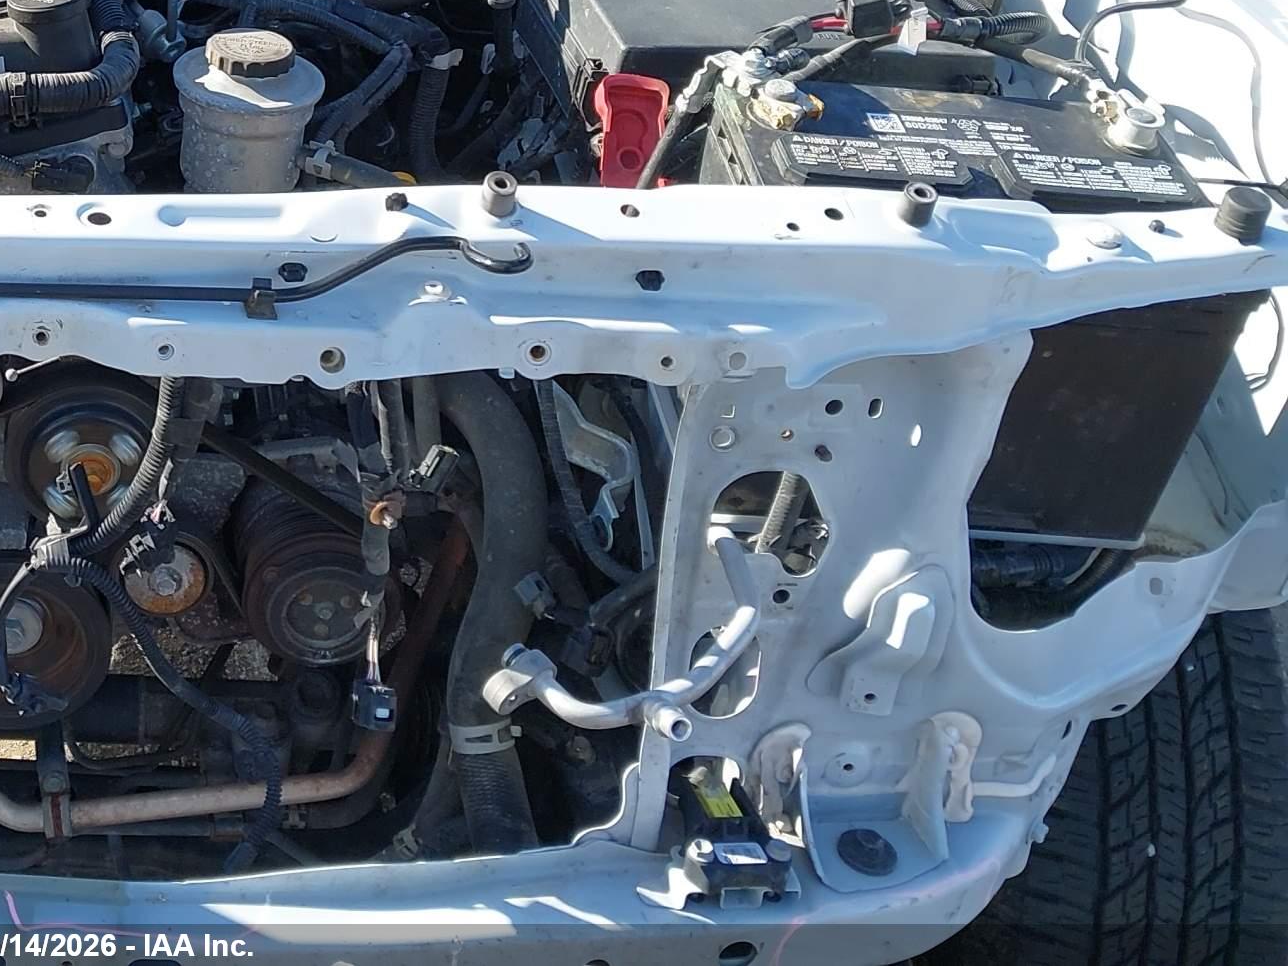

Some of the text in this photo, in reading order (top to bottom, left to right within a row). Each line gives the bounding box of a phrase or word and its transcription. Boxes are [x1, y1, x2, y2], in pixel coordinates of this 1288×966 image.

[803, 135, 839, 146] DANGER
[845, 139, 880, 149] POISON
[1023, 153, 1061, 163] DANGER
[1067, 156, 1102, 166] POISON
